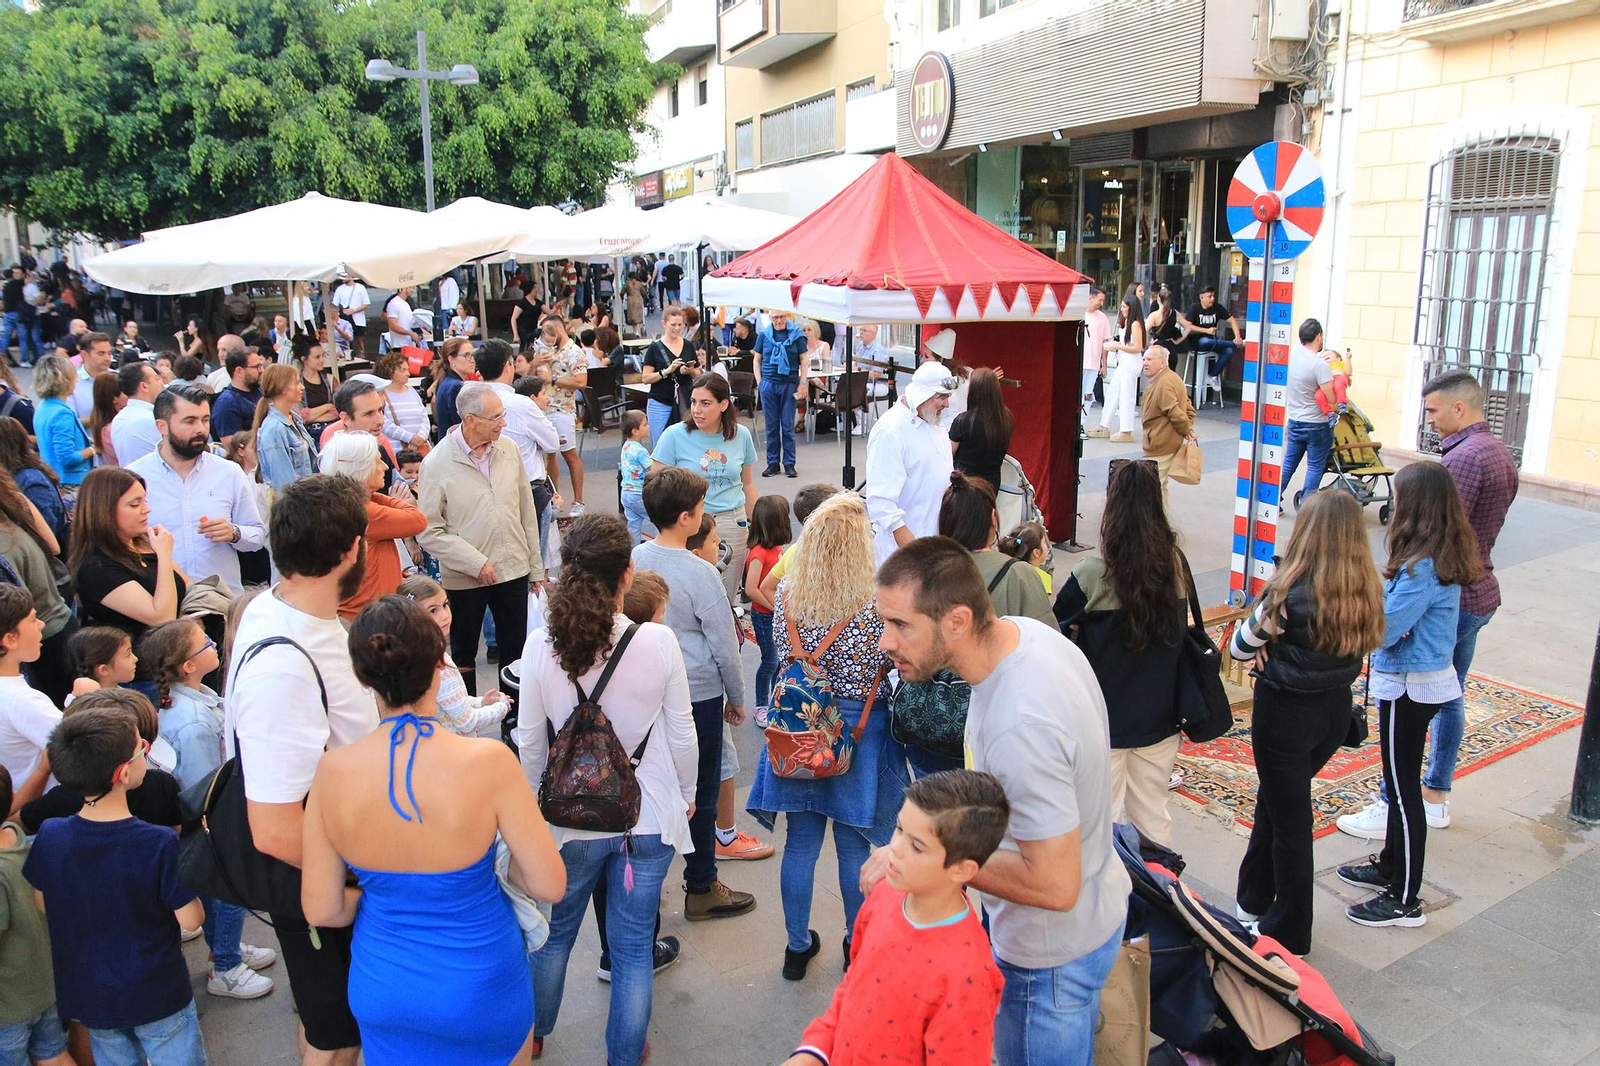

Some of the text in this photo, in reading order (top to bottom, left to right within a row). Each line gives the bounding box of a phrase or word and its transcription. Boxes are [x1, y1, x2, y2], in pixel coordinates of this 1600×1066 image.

[599, 237, 642, 247] Cruzcampo
[1280, 242, 1289, 252] 19
[1281, 266, 1290, 275] 18
[1280, 288, 1289, 297] 17
[1278, 309, 1287, 318] 16
[1277, 330, 1286, 339] 15
[1275, 371, 1283, 380] 13
[1273, 391, 1282, 400] 12
[1272, 411, 1280, 420] 11
[1270, 431, 1279, 440] 10
